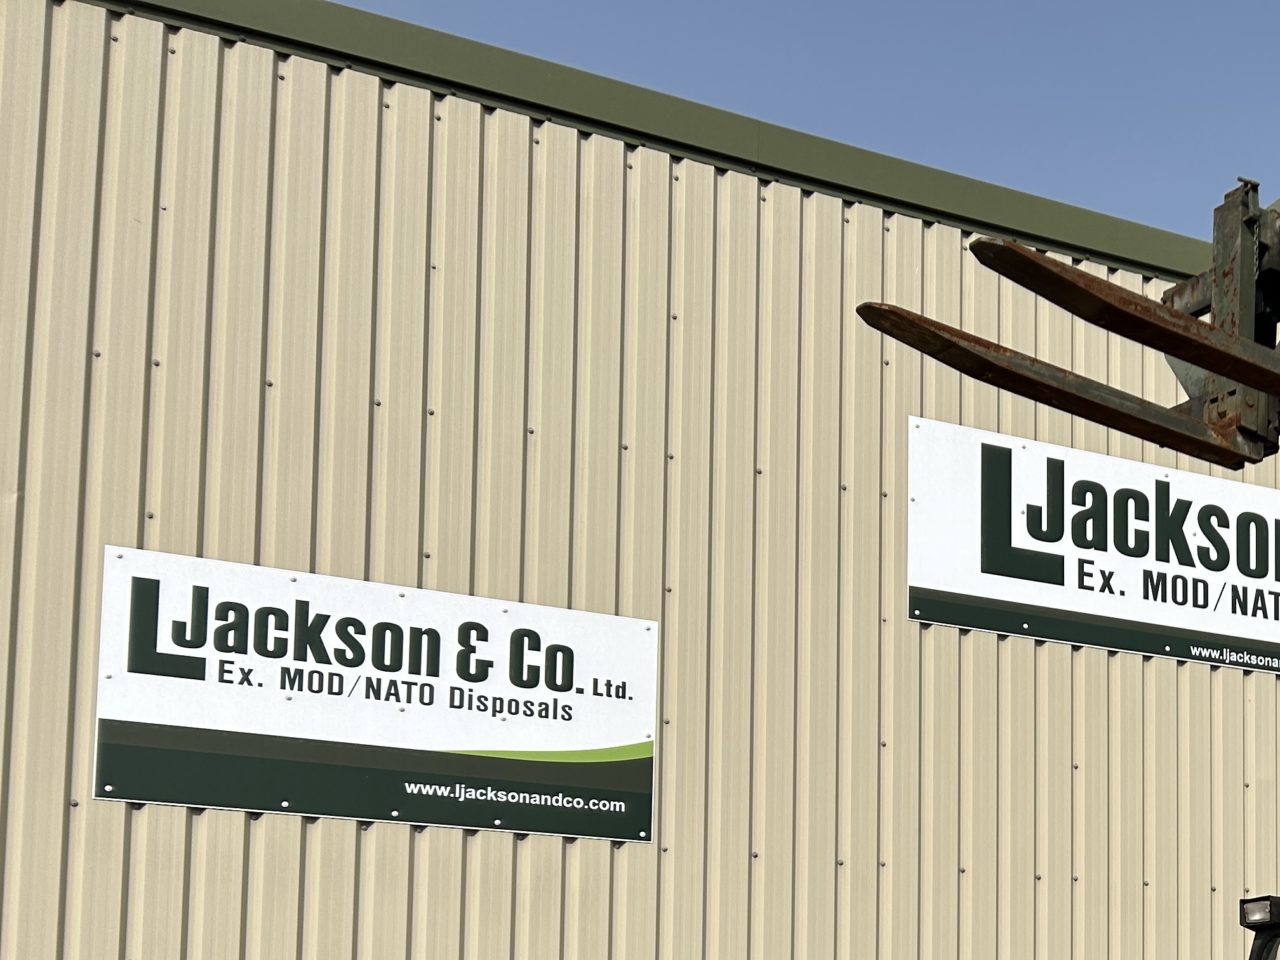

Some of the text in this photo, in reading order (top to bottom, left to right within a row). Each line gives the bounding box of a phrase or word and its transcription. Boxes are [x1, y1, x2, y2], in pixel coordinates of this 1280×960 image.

[1077, 557, 1126, 597] Ex.
[455, 621, 494, 684] &
[508, 628, 585, 695] Co.
[592, 677, 634, 701] Ltd.
[218, 659, 573, 722] Ex. MOD/NATO Disposals
[404, 780, 626, 813] www.ljacksonandco.com
